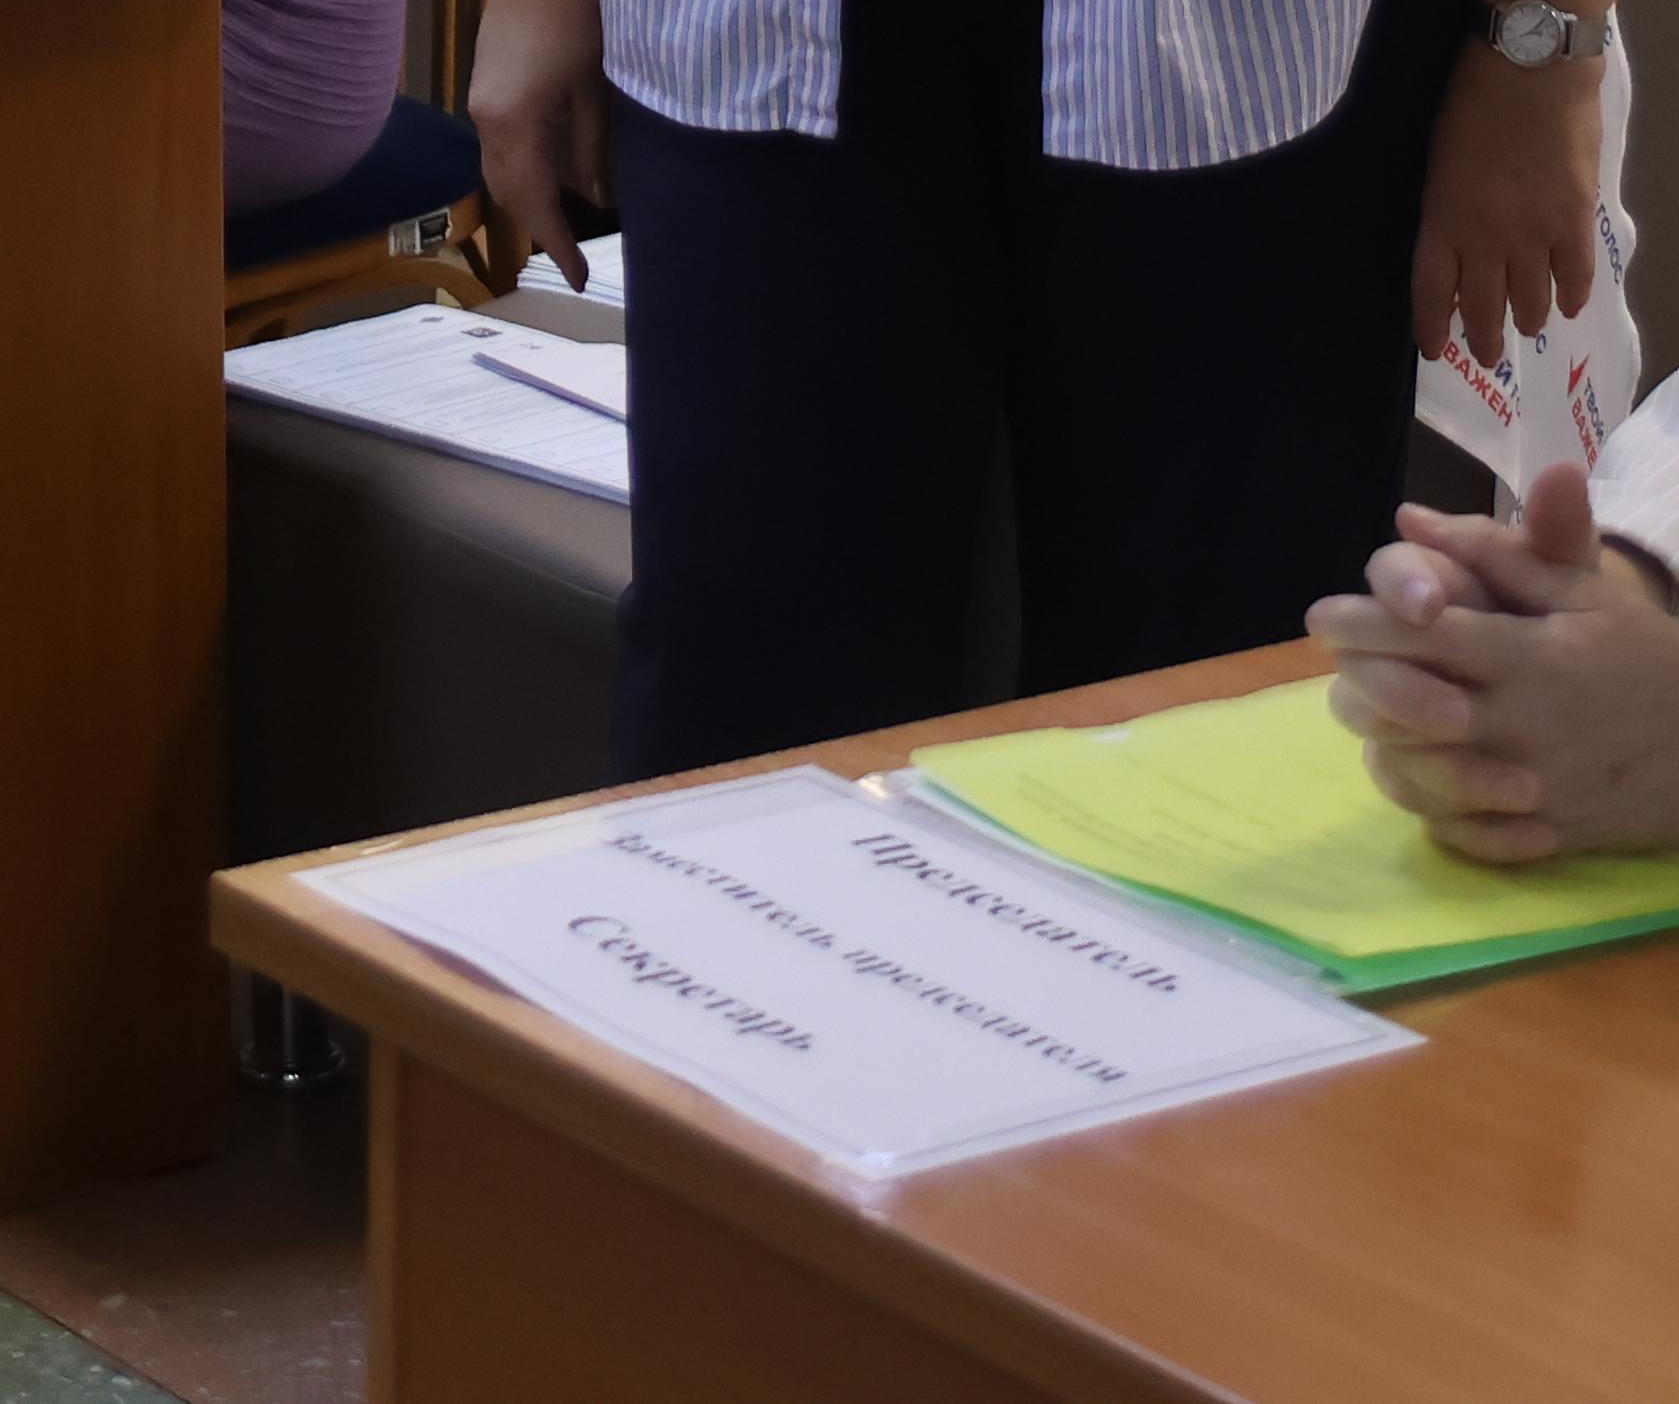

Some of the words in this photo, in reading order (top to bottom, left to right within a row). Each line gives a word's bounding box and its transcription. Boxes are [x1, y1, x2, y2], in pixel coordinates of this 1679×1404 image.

[1442, 340, 1513, 428] ВАЖЕН
[1571, 396, 1598, 471] ВАЖЕ
[608, 833, 835, 949] Заместитель
[843, 949, 1130, 1084] председателя
[850, 834, 1180, 993] Председатель
[568, 914, 814, 1052] Секретарь
